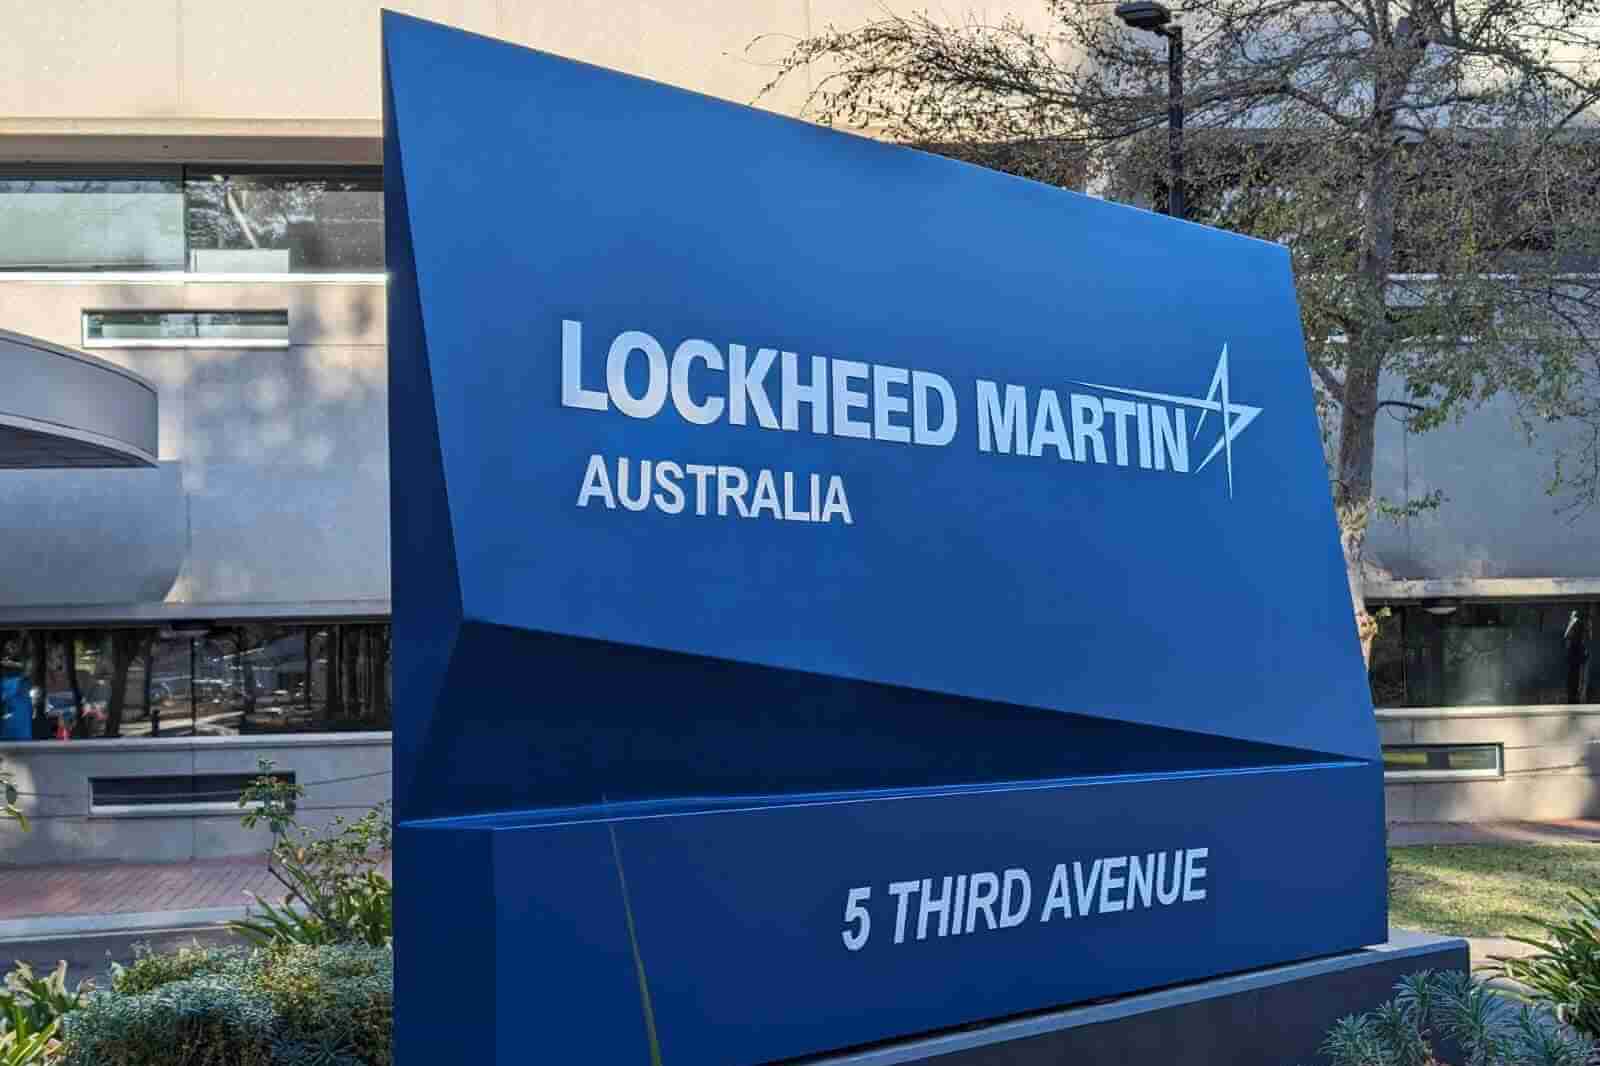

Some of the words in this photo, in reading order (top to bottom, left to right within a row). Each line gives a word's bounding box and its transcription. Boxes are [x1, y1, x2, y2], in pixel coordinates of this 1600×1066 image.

[561, 318, 958, 447] LOCKHEED
[976, 379, 1190, 474] MARTIN
[577, 453, 853, 525] AUSTRALIA
[841, 885, 872, 952] 5
[888, 867, 1032, 944] THIRD
[1040, 846, 1210, 923] AVENUE
